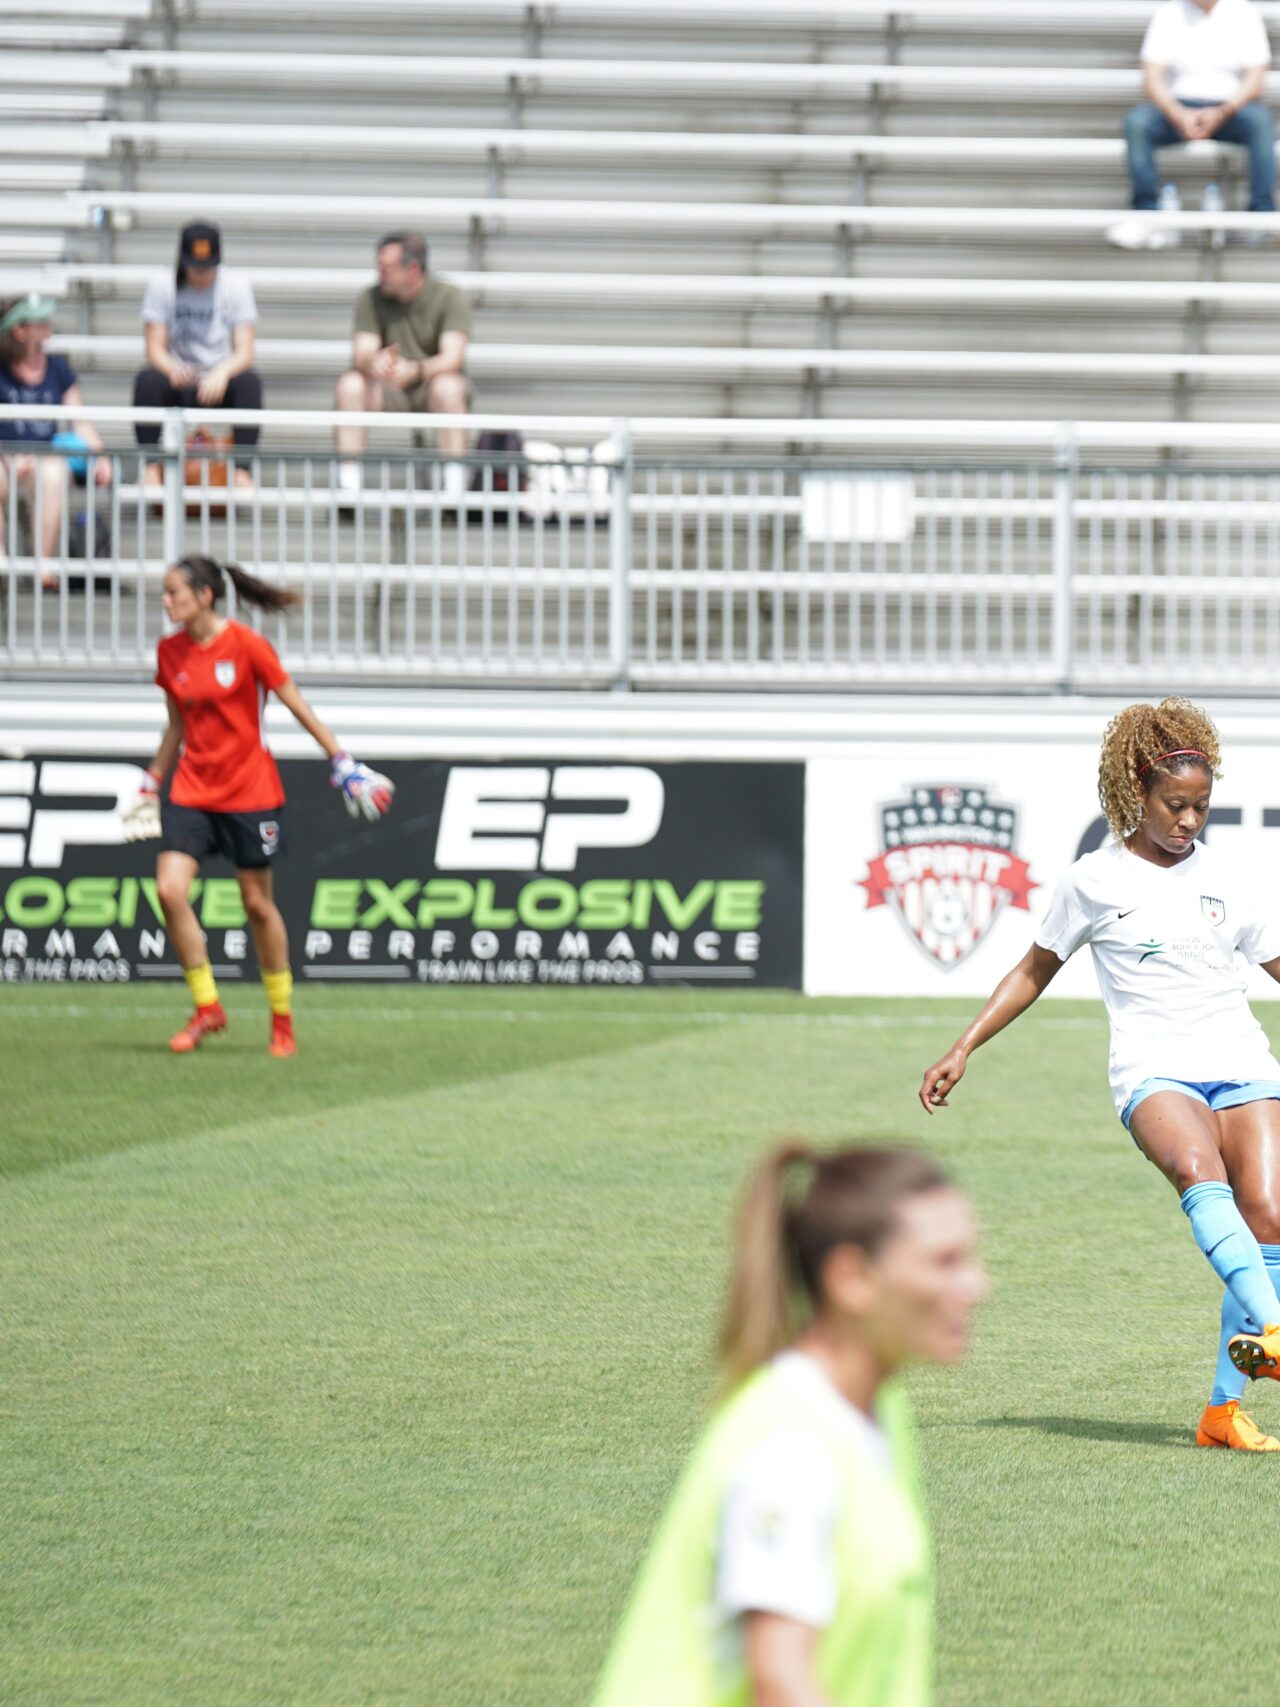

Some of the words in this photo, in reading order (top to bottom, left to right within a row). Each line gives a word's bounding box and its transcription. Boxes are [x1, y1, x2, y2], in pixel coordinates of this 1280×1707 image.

[434, 766, 665, 871] EP
[884, 844, 1013, 885] SPIRIT
[309, 878, 766, 931] EXPLOSIVE
[304, 929, 762, 961] PERFORMANCE
[417, 958, 484, 982] TRAIN
[485, 959, 535, 983] LIKE
[538, 959, 580, 983] THE
[583, 960, 645, 984] PROS
